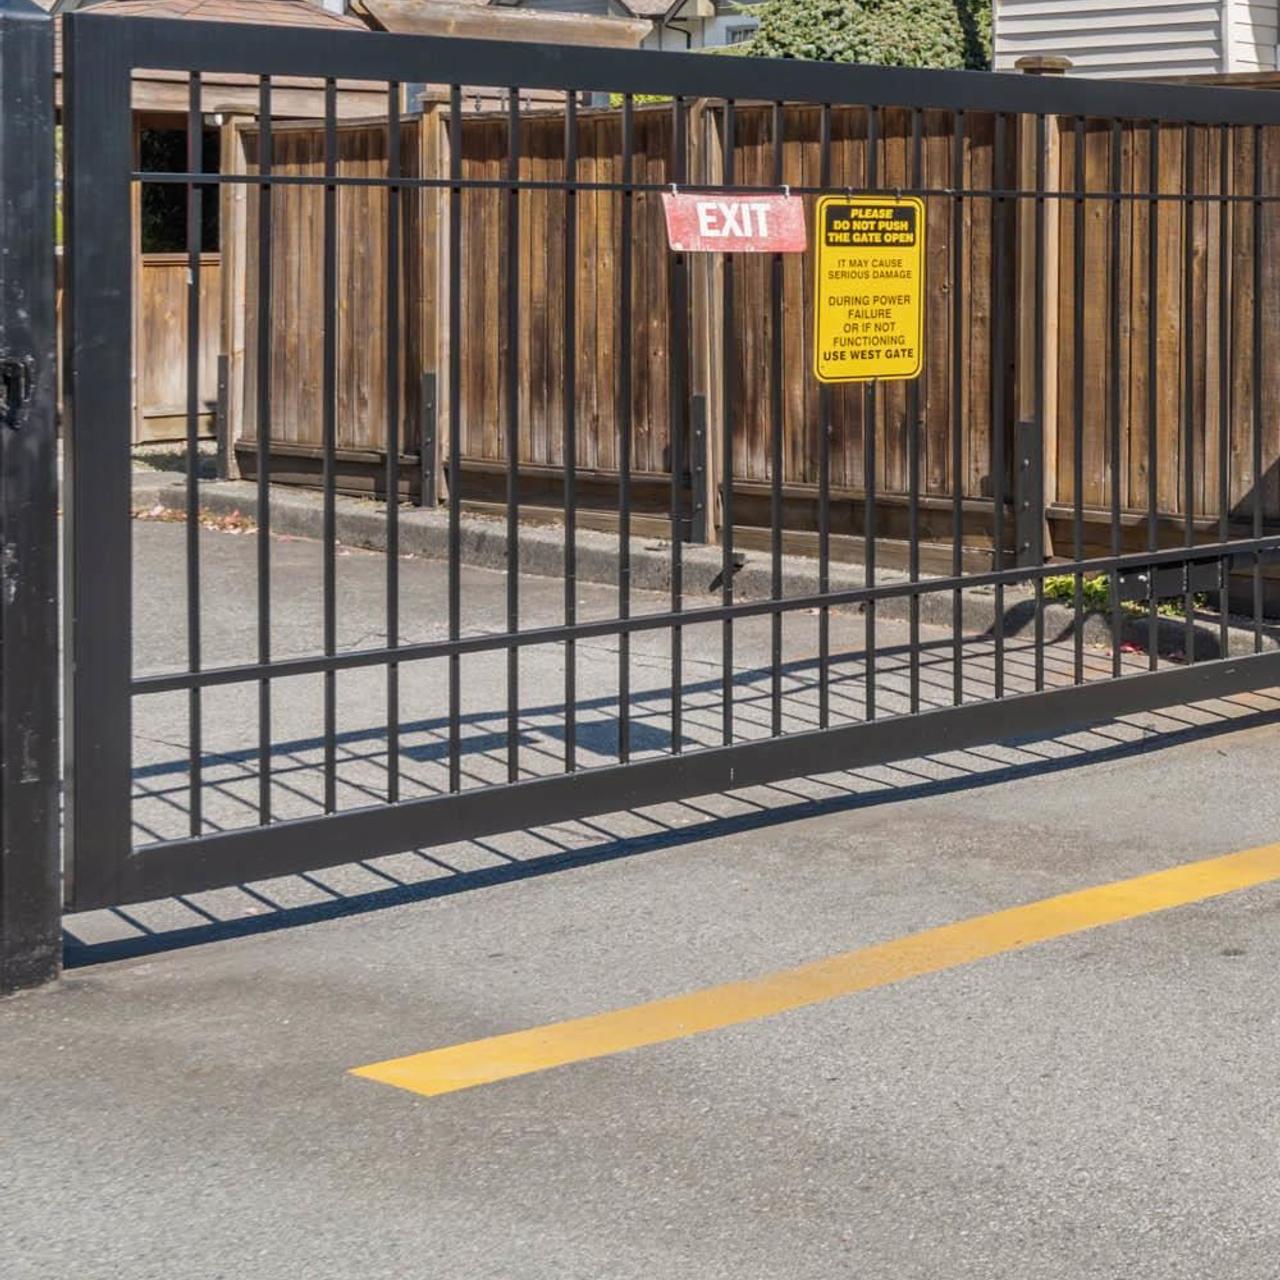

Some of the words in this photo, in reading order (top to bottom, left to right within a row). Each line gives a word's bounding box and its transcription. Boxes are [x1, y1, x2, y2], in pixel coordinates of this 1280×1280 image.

[850, 208, 894, 219] PLEASE
[696, 202, 771, 237] EXIT
[833, 220, 850, 231] DO
[852, 220, 876, 231] NOT
[878, 220, 909, 231] PUSH
[827, 232, 850, 243] THE
[852, 232, 882, 243] GATE
[883, 232, 914, 243] OPEN
[837, 259, 846, 268] IT
[849, 259, 869, 268] MAY
[871, 259, 903, 268] CAUSE
[827, 270, 870, 280] SERIOUS
[872, 270, 912, 279] DAMAGE
[828, 295, 870, 306] DURING
[872, 295, 911, 306] POWER
[848, 308, 892, 319] FAILURE
[843, 323, 859, 333] OR
[862, 322, 872, 333] IF
[874, 321, 896, 332] NOT
[833, 335, 905, 347] FUNCTIONING
[823, 350, 846, 361] USE
[850, 349, 882, 360] WEST
[885, 348, 914, 359] GATE
